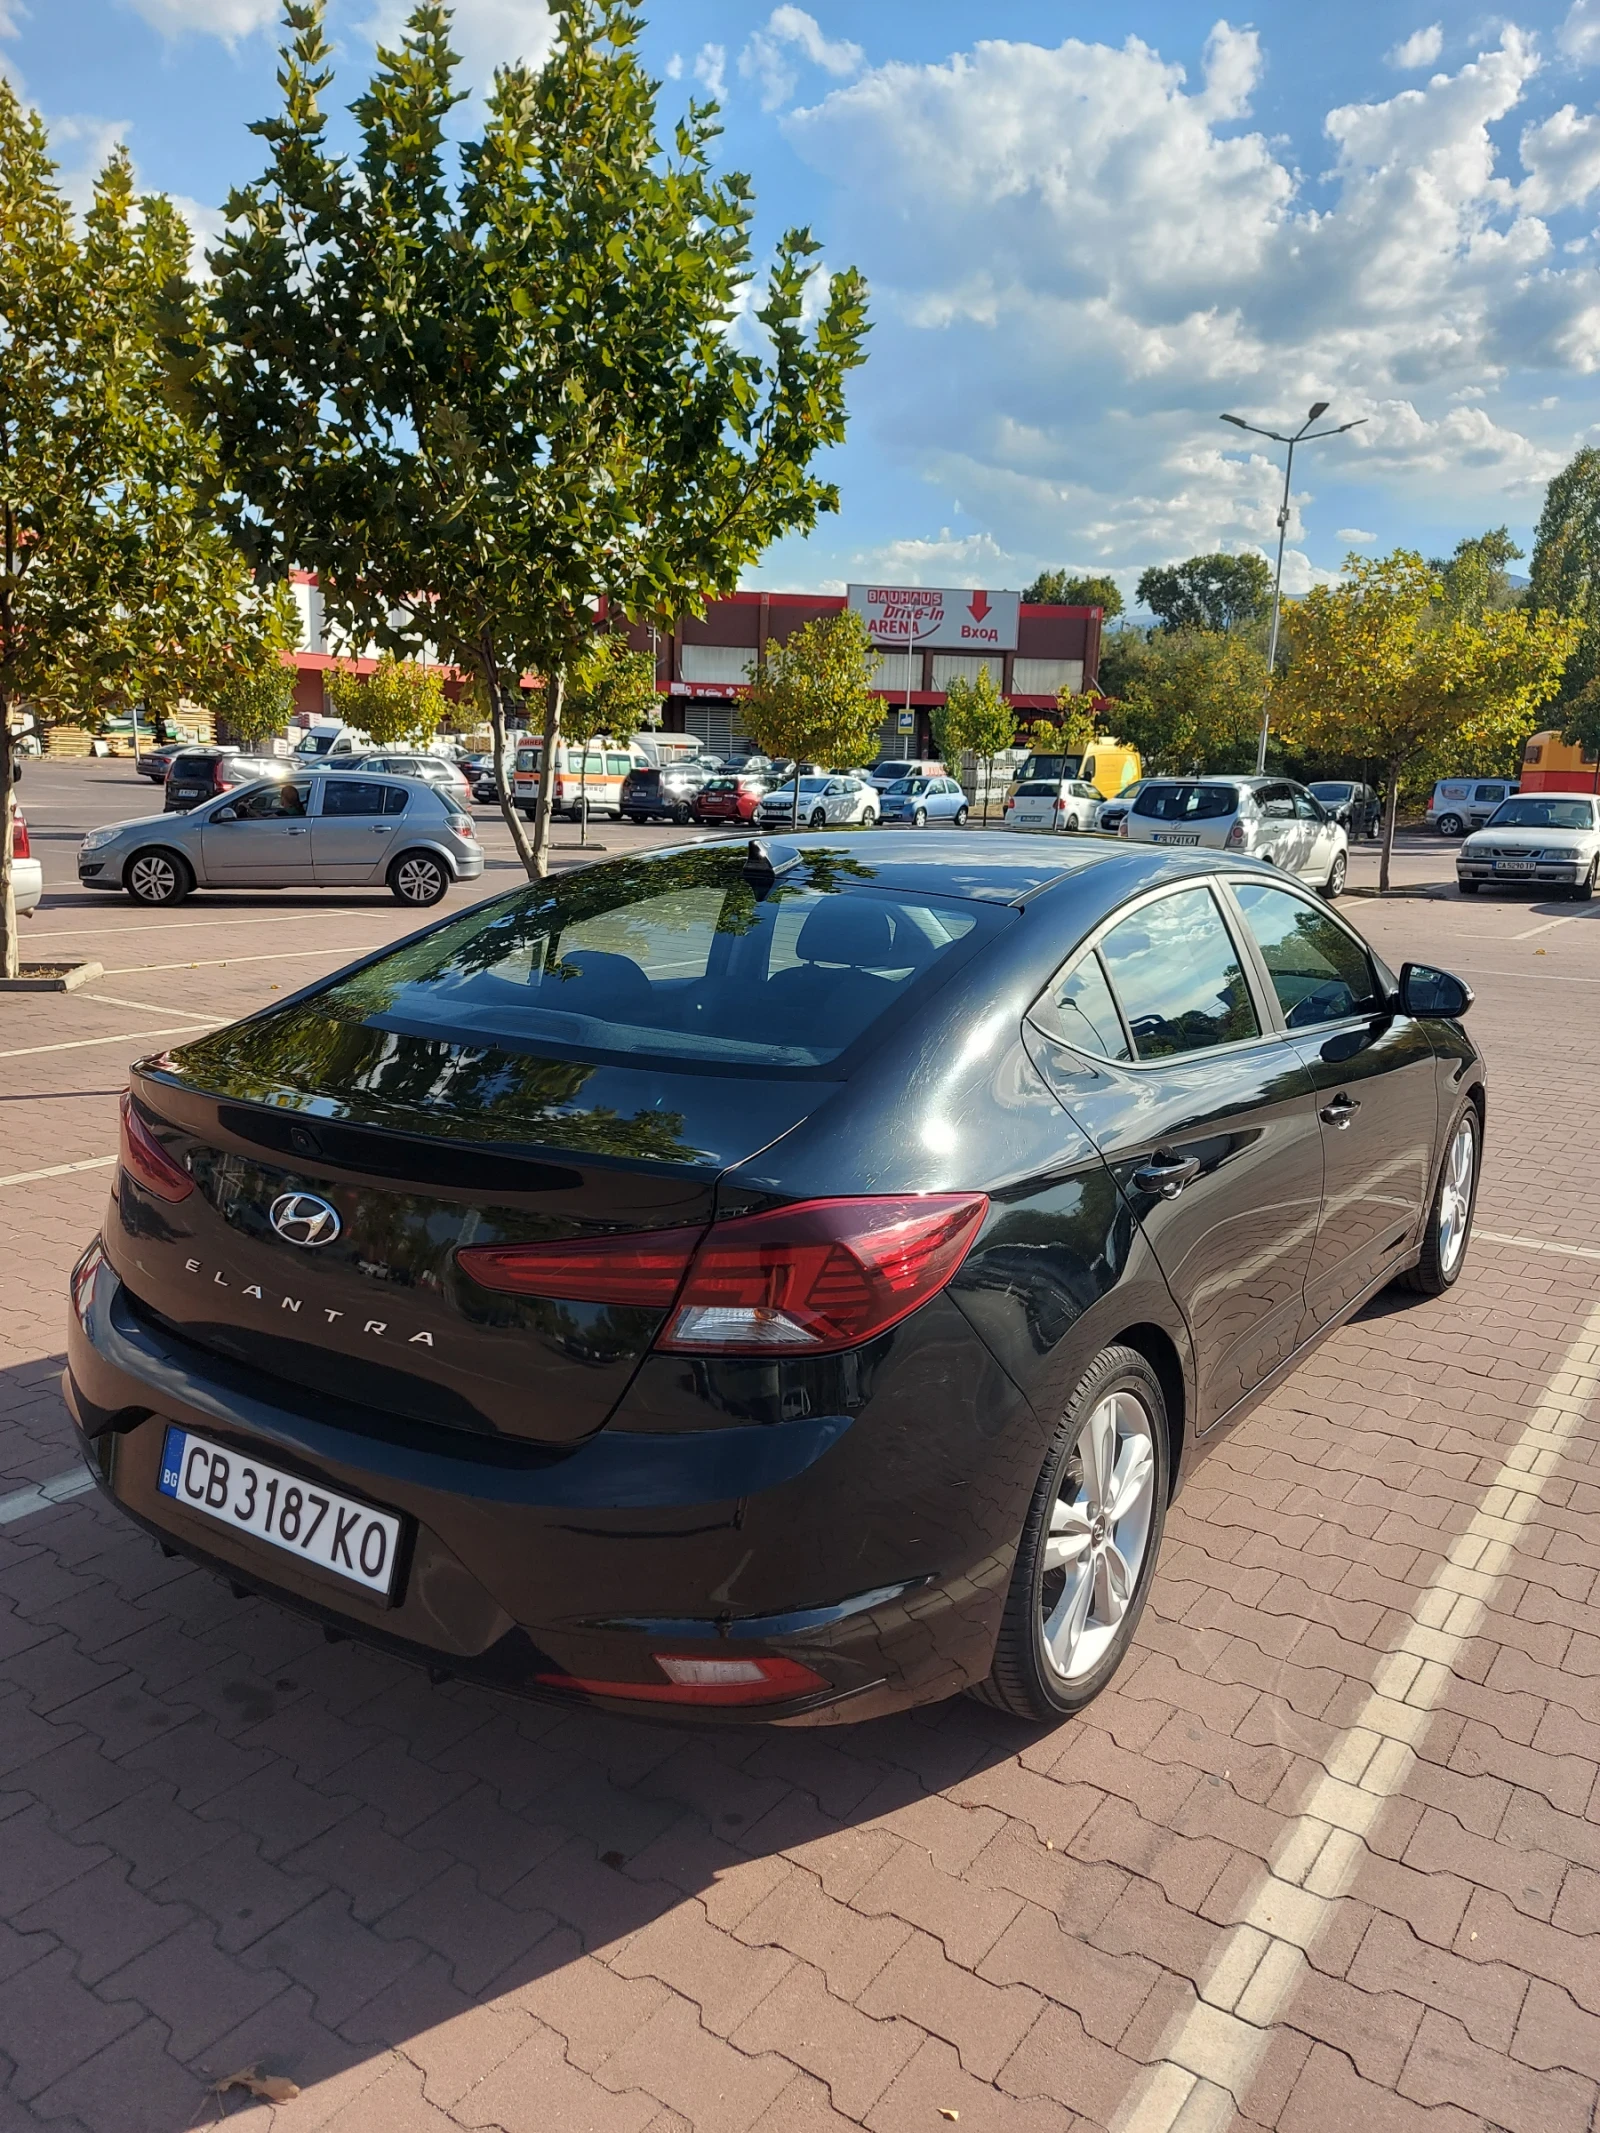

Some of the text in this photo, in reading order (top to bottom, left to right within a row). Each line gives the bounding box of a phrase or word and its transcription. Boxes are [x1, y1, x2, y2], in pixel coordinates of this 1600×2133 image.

[867, 589, 943, 606] BAUHAUS
[883, 605, 945, 621] Drive-In
[867, 619, 920, 635] ARENA
[961, 625, 998, 642] Вход
[185, 1258, 435, 1346] ELANTRA
[163, 1468, 178, 1488] BG
[184, 1446, 387, 1578] CB 3187 KO
